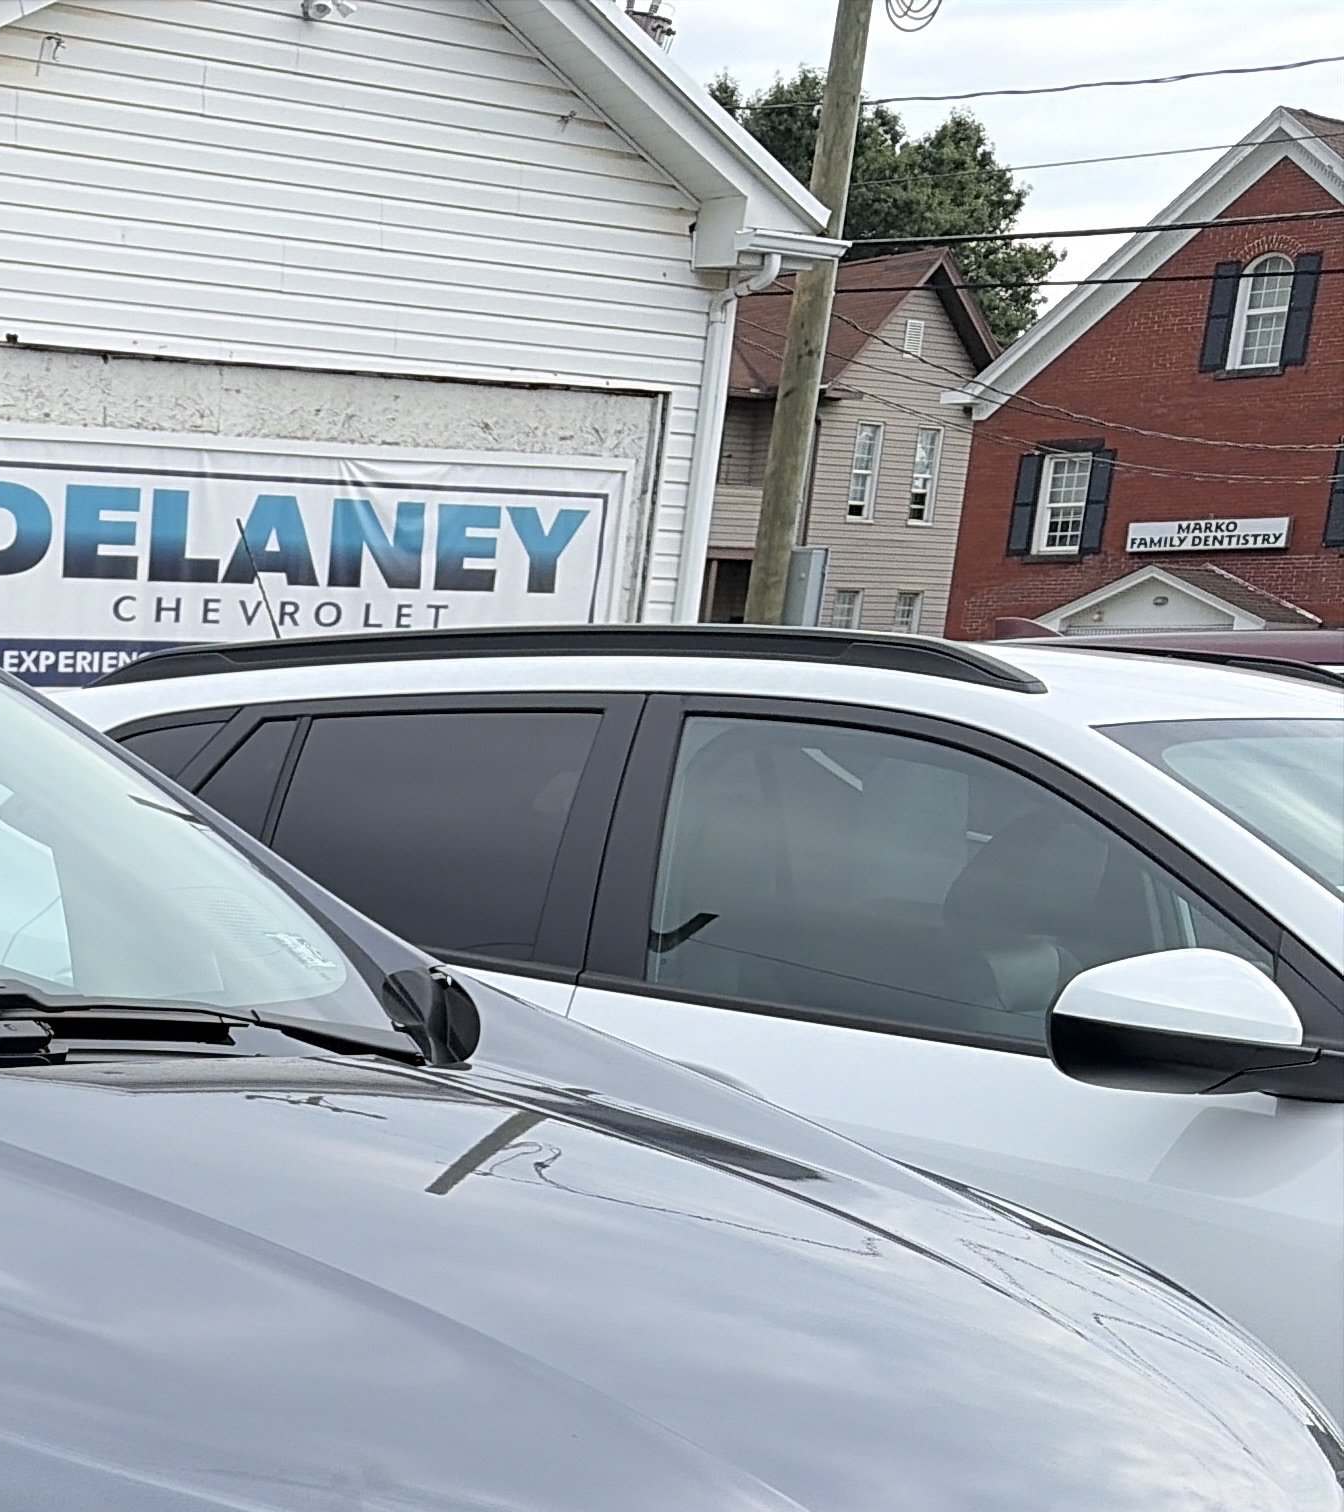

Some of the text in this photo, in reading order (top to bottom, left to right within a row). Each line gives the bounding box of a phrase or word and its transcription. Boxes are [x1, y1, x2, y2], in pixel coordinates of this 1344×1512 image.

[1177, 521, 1238, 534] MARKO
[1130, 533, 1283, 549] FAMILY DENTISTRY
[112, 594, 450, 630] CHEVROLET
